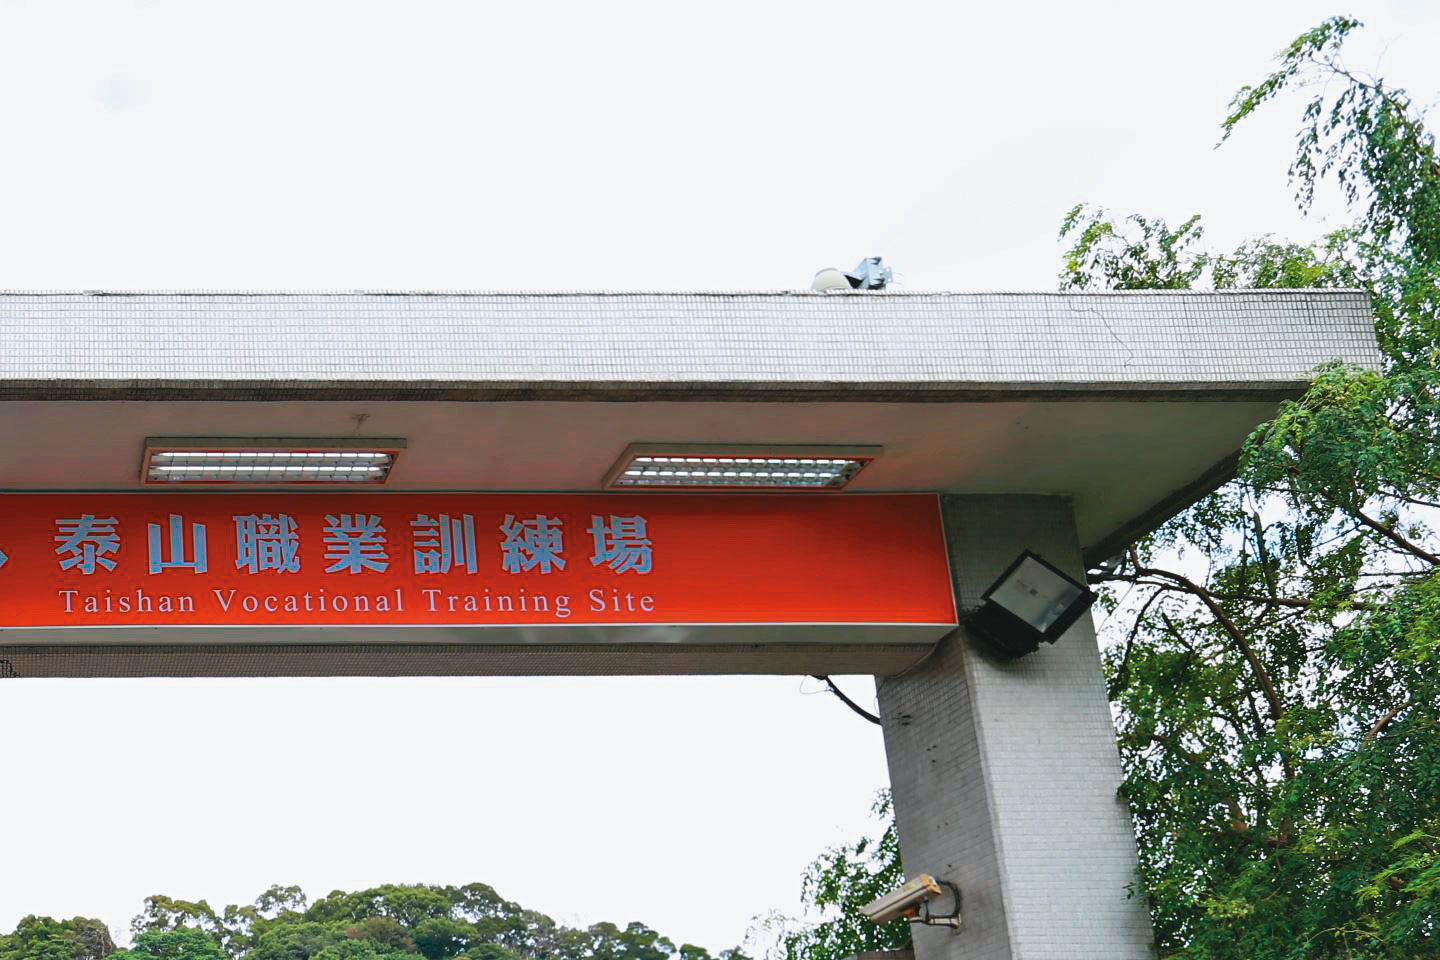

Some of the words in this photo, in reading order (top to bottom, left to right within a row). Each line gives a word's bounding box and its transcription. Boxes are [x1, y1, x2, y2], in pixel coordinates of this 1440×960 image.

[54, 513, 653, 575] 泰山職業訓練場
[58, 589, 195, 613] Taishan
[212, 588, 404, 613] Vocational
[422, 588, 572, 618] Training
[589, 588, 656, 612] Site
